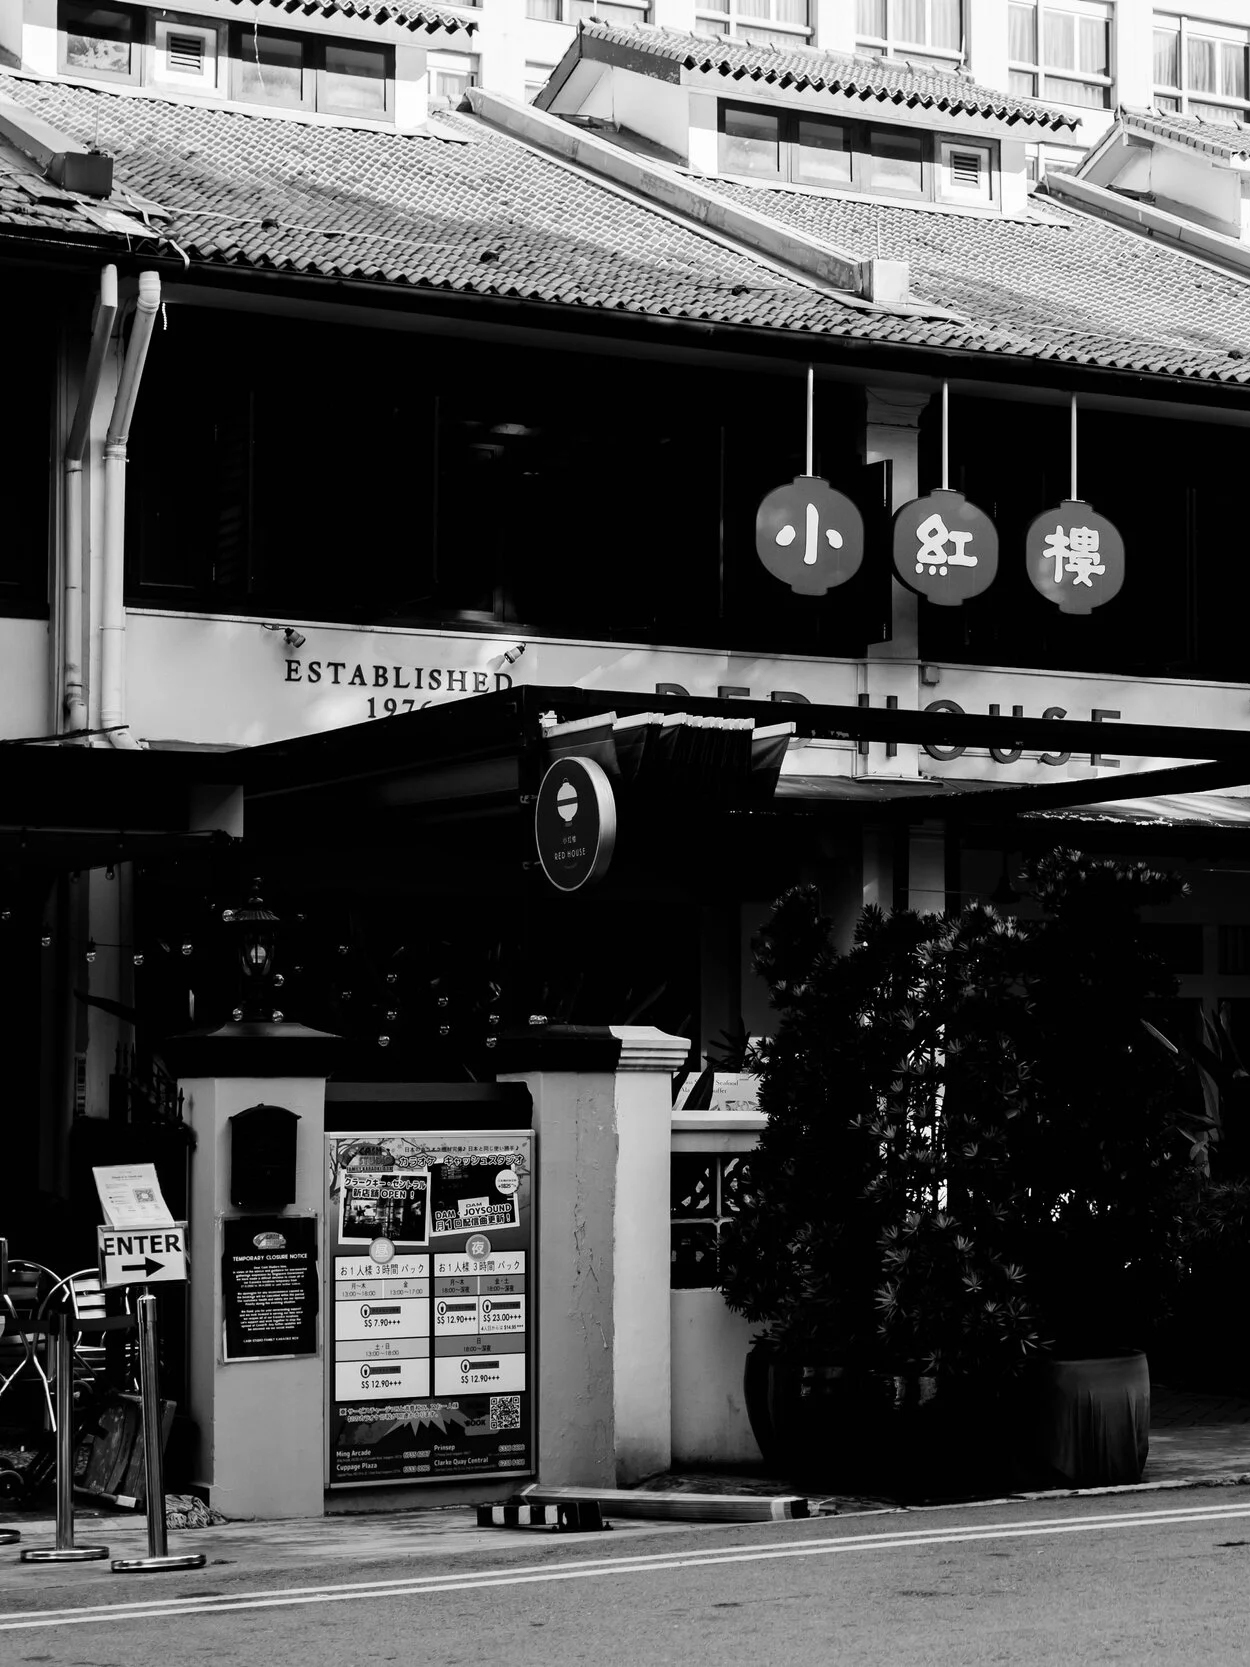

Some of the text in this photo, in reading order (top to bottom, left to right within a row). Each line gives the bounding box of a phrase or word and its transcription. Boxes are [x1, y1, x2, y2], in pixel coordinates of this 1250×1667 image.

[285, 659, 513, 693] ESTABLISHED
[367, 696, 433, 719] 197
[554, 847, 586, 860] RED HOUSE
[400, 1154, 524, 1167] カラオケ キャッシュスタジオ
[103, 1234, 182, 1256] ENTER
[471, 1242, 485, 1255] 夜
[447, 1315, 476, 1323] 12.90+++
[492, 1313, 521, 1321] 23.00+++
[374, 1318, 401, 1327] 7.90+++
[470, 1374, 500, 1383] 12.90+++
[371, 1379, 402, 1388] 12.90+++
[434, 1444, 456, 1452] Prinsep
[336, 1450, 351, 1459] Ming
[434, 1458, 452, 1466] Clarke
[453, 1458, 467, 1466] Quay
[468, 1456, 489, 1464] Central
[336, 1464, 361, 1472] Cuppage
